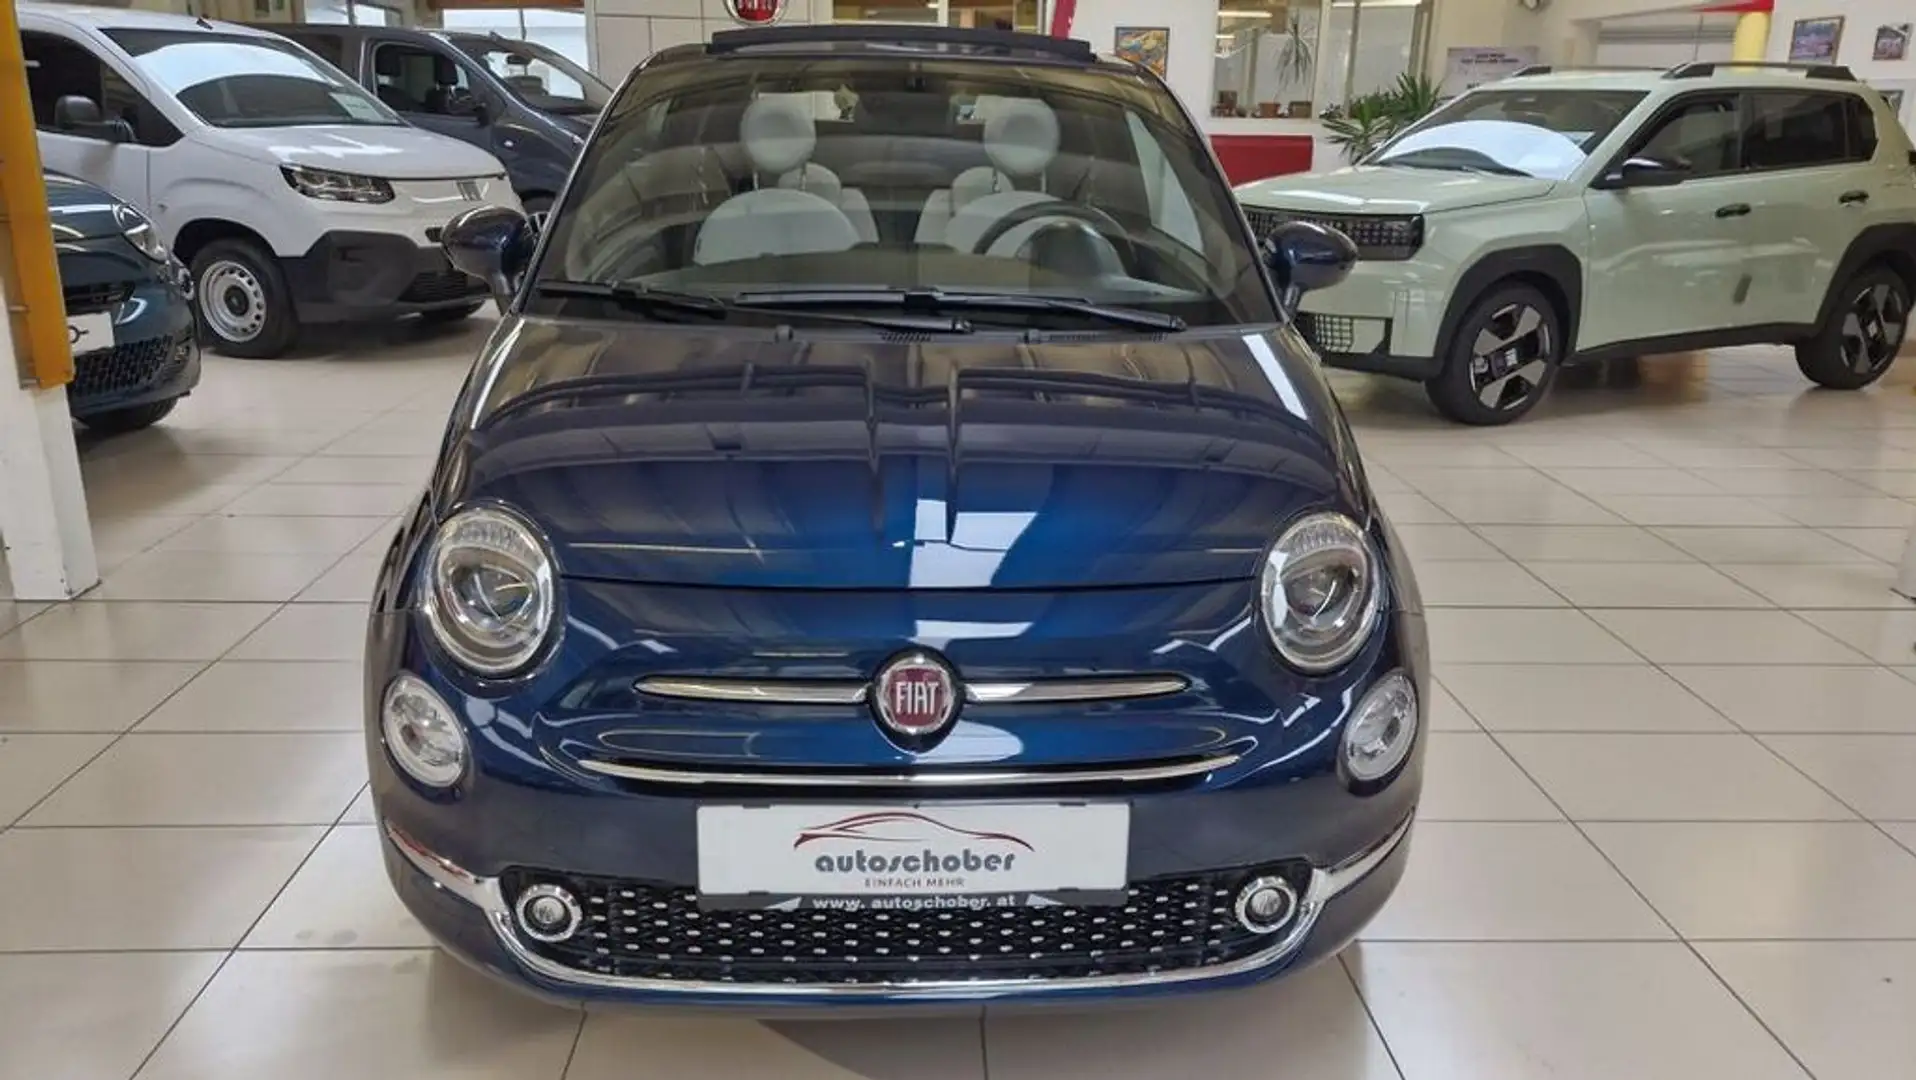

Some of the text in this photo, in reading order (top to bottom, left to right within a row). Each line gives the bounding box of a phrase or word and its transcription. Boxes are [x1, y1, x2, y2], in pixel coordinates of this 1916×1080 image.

[896, 681, 939, 715] FIAT
[815, 849, 1015, 873] autoschober
[864, 877, 965, 889] EINFACH MEHR
